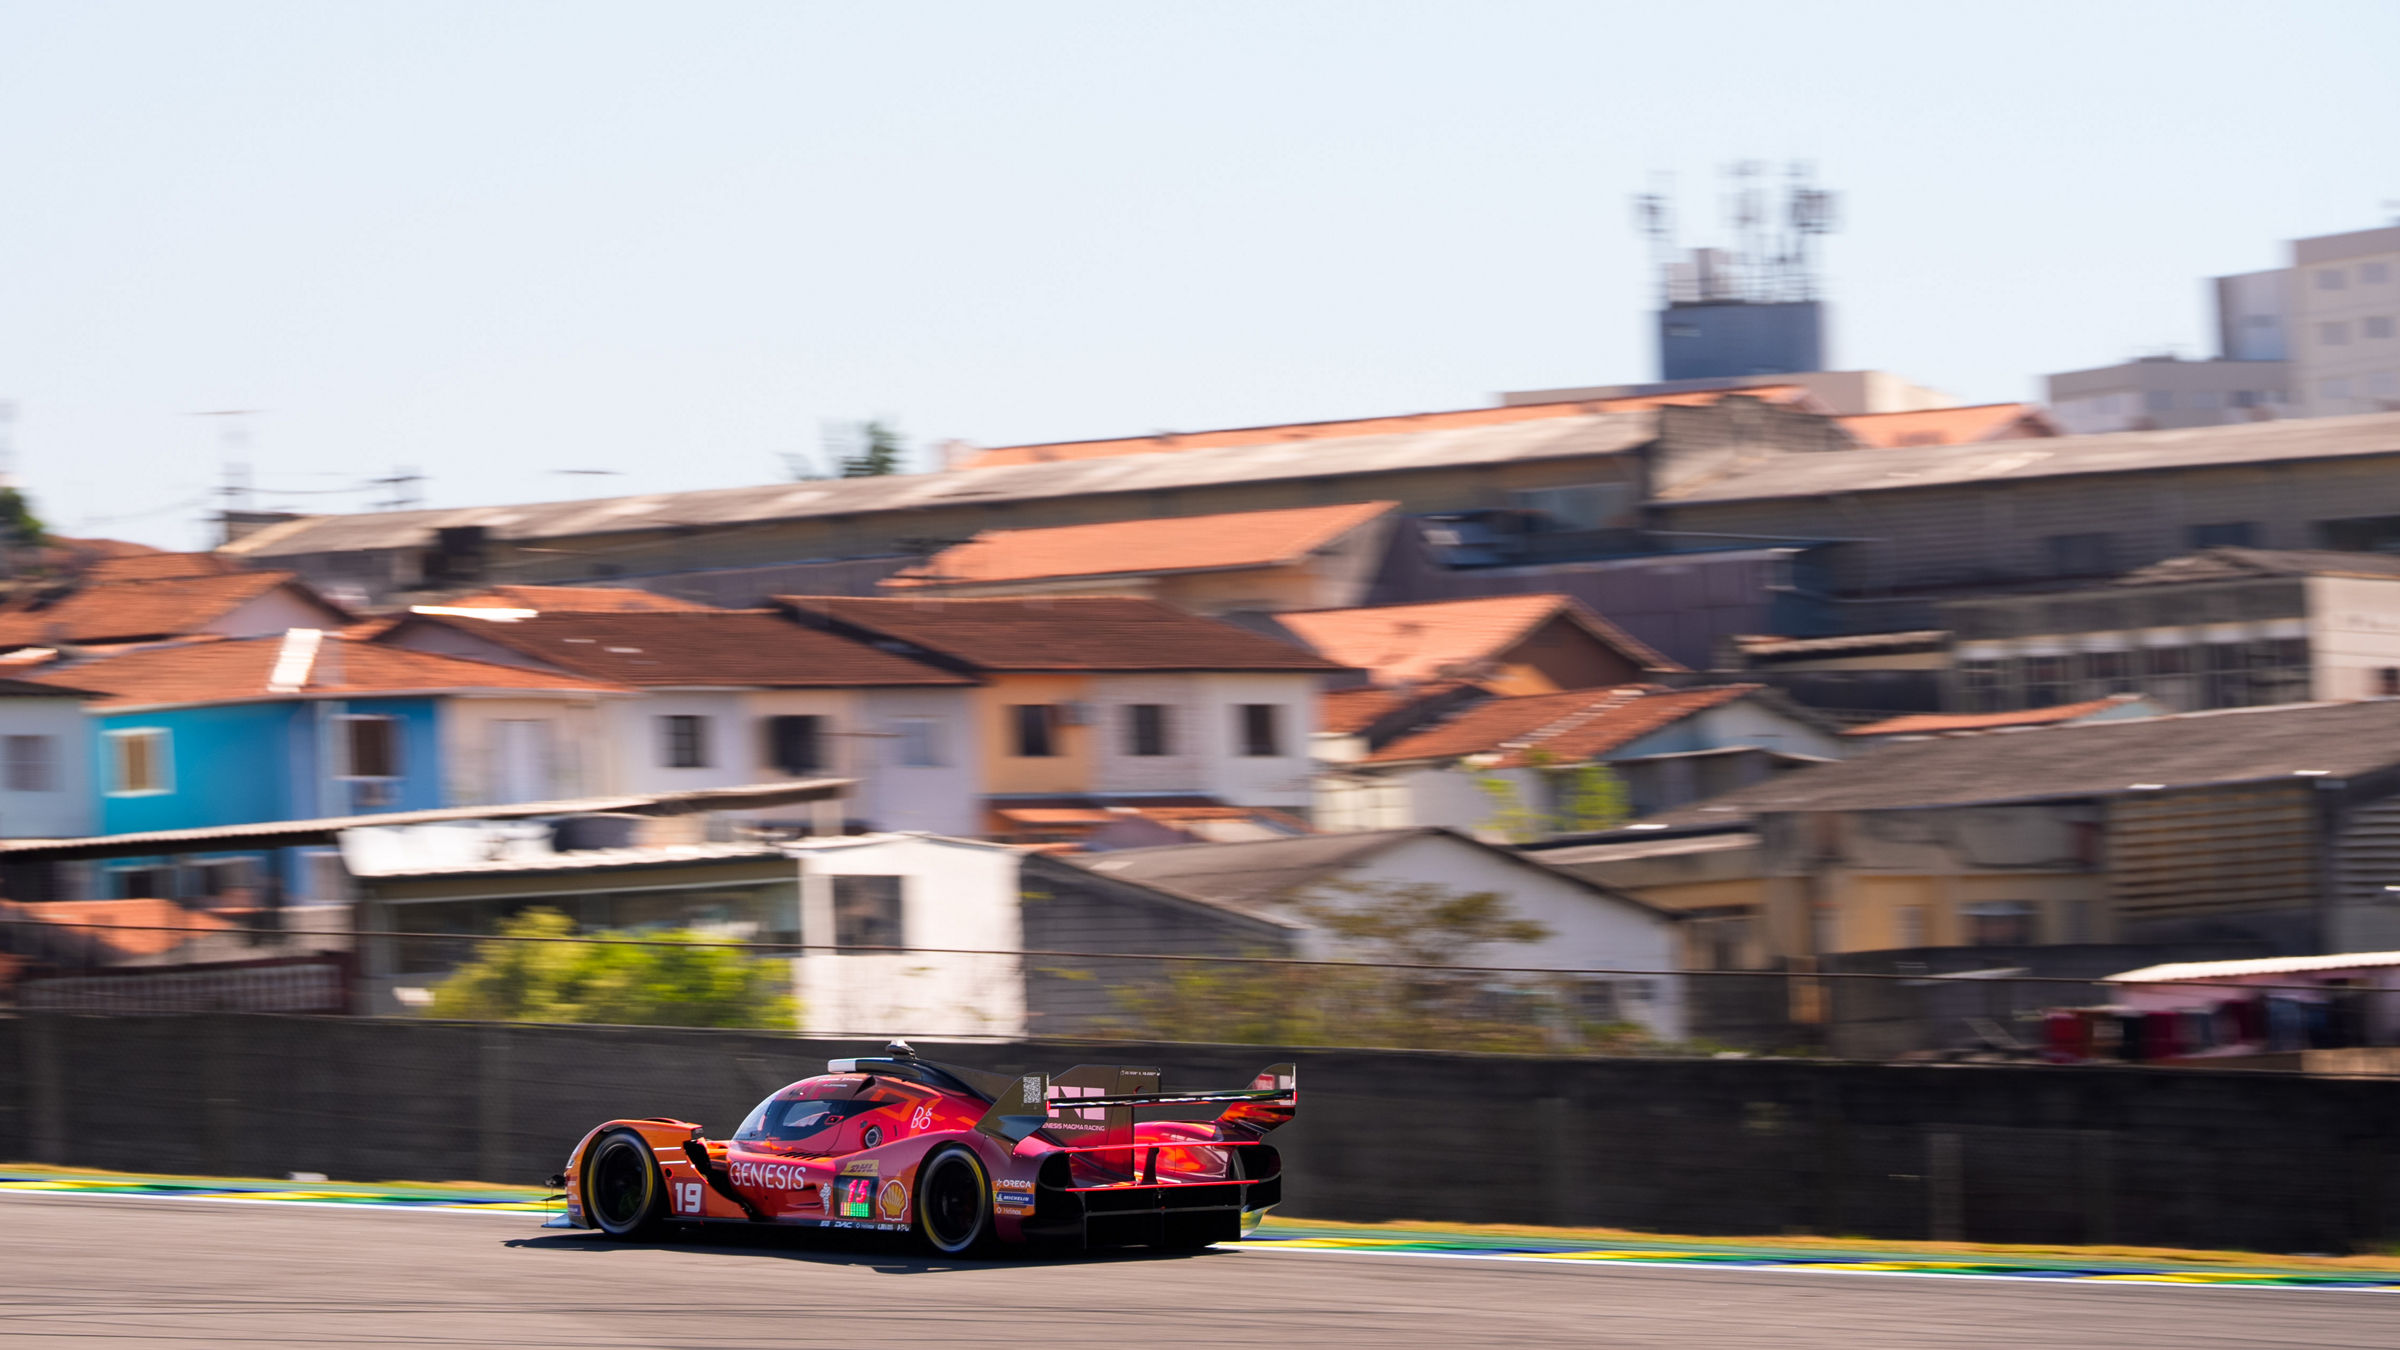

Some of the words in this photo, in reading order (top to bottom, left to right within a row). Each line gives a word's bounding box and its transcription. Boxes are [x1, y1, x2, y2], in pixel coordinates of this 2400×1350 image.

[1063, 1123, 1084, 1131] MAGMA
[1084, 1124, 1105, 1132] RACING
[729, 1162, 806, 1190] GENESIS
[1003, 1179, 1032, 1189] ORECA
[675, 1182, 702, 1213] 19
[848, 1179, 870, 1203] 15
